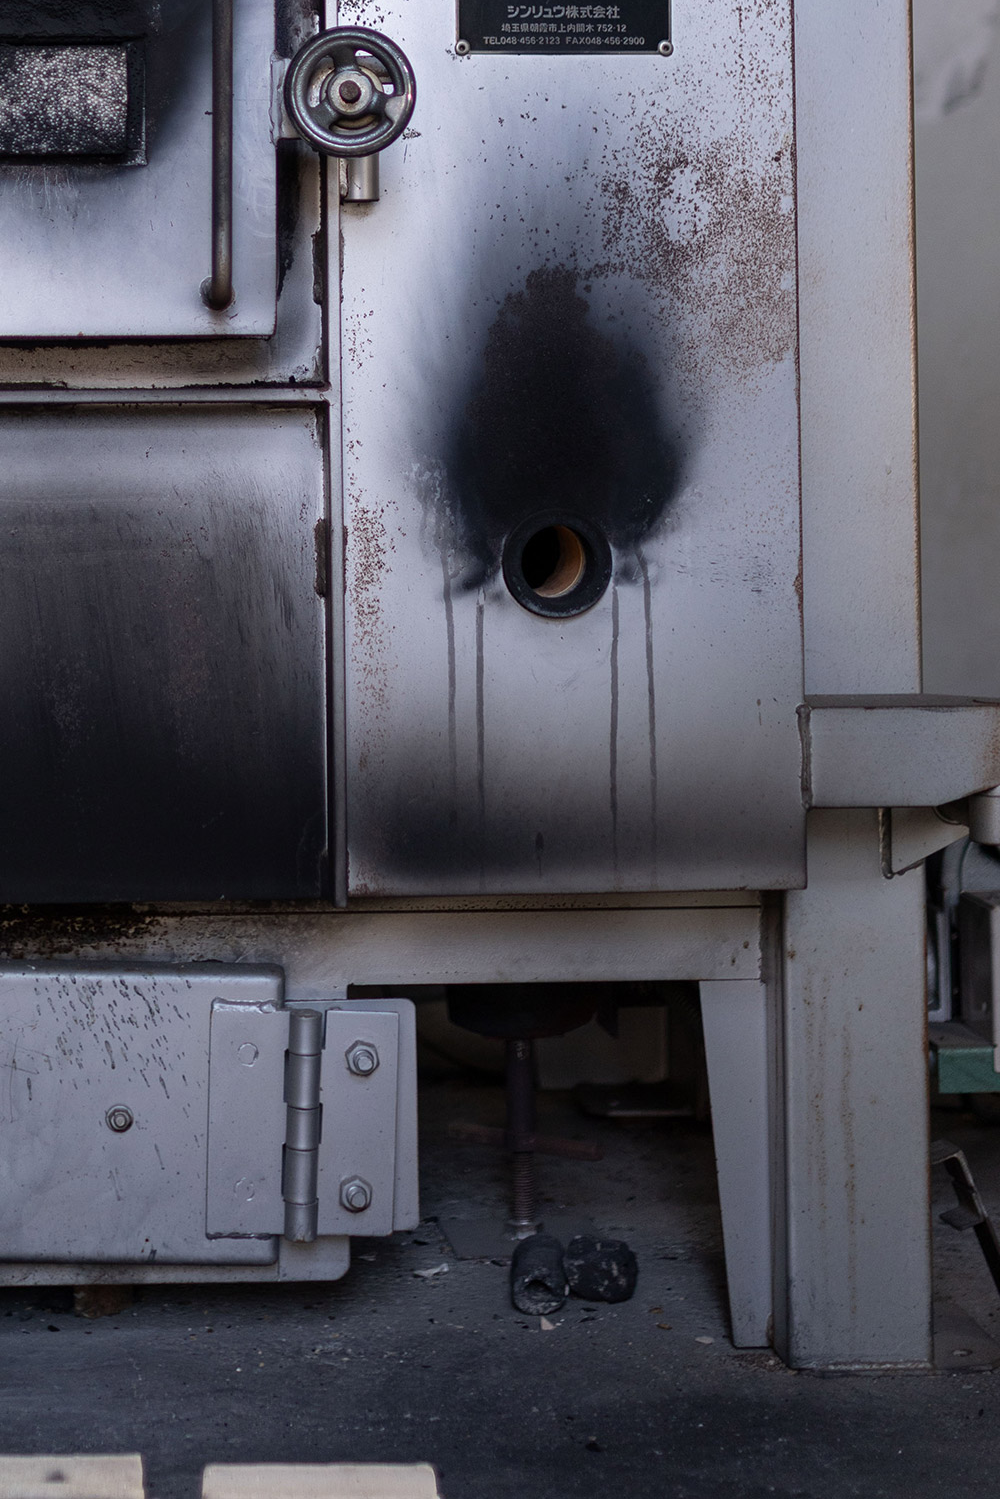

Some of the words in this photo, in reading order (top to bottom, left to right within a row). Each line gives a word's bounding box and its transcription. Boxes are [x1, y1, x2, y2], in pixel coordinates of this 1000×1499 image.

[507, 5, 620, 19] シンリュウ株式会社
